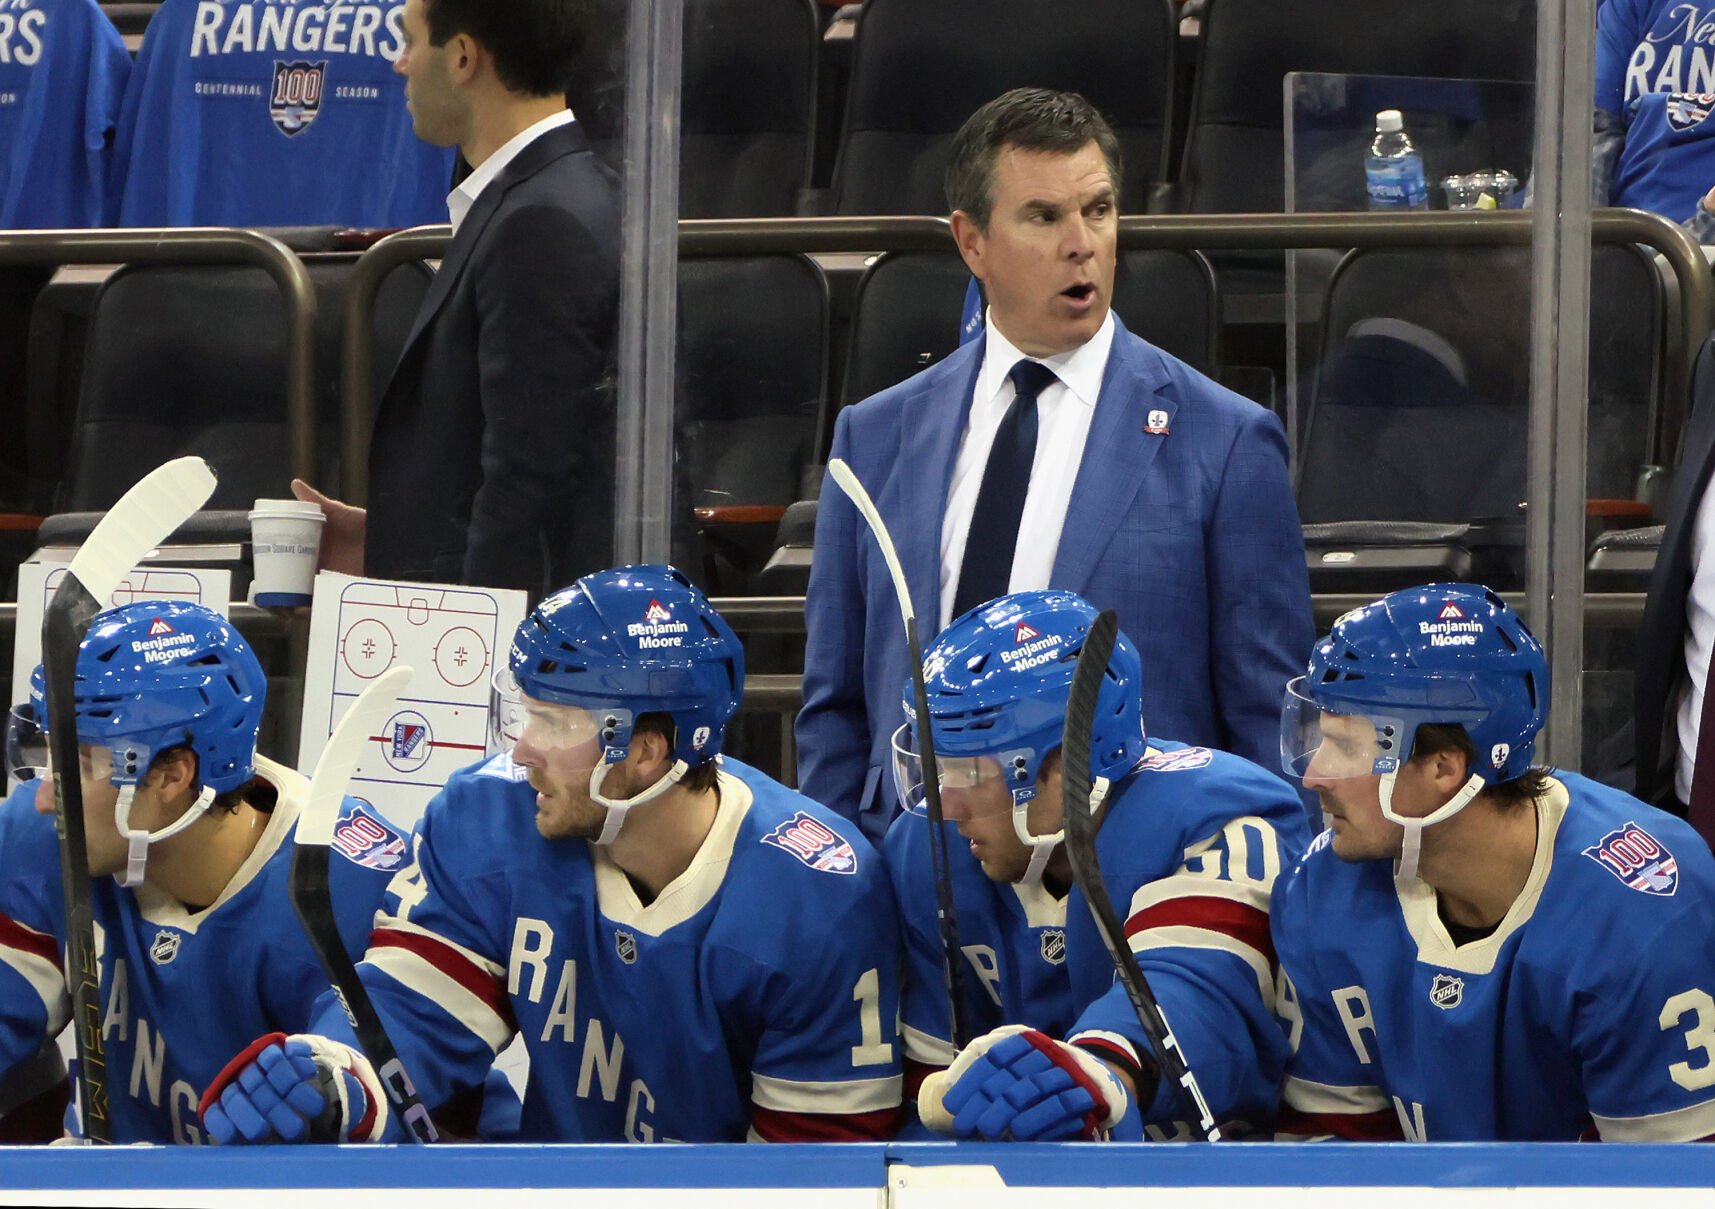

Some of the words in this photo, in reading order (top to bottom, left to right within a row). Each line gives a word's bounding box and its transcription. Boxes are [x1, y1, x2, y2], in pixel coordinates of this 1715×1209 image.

[190, 2, 407, 62] RANGERS
[194, 82, 262, 95] CENTENNIAL
[335, 87, 378, 98] SEASON
[273, 68, 321, 105] 100
[627, 620, 688, 637] Benjamin
[1419, 619, 1483, 635] Benjamin
[131, 632, 195, 653] Benjamin
[639, 636, 682, 650] Moore
[1000, 634, 1062, 663] Benjamin
[1431, 633, 1477, 647] Moore
[144, 647, 188, 663] Moore
[1014, 649, 1058, 672] Moore
[777, 819, 834, 860] 100
[1599, 829, 1660, 877] 100
[852, 967, 900, 1068] 1
[508, 917, 686, 1143] RANG
